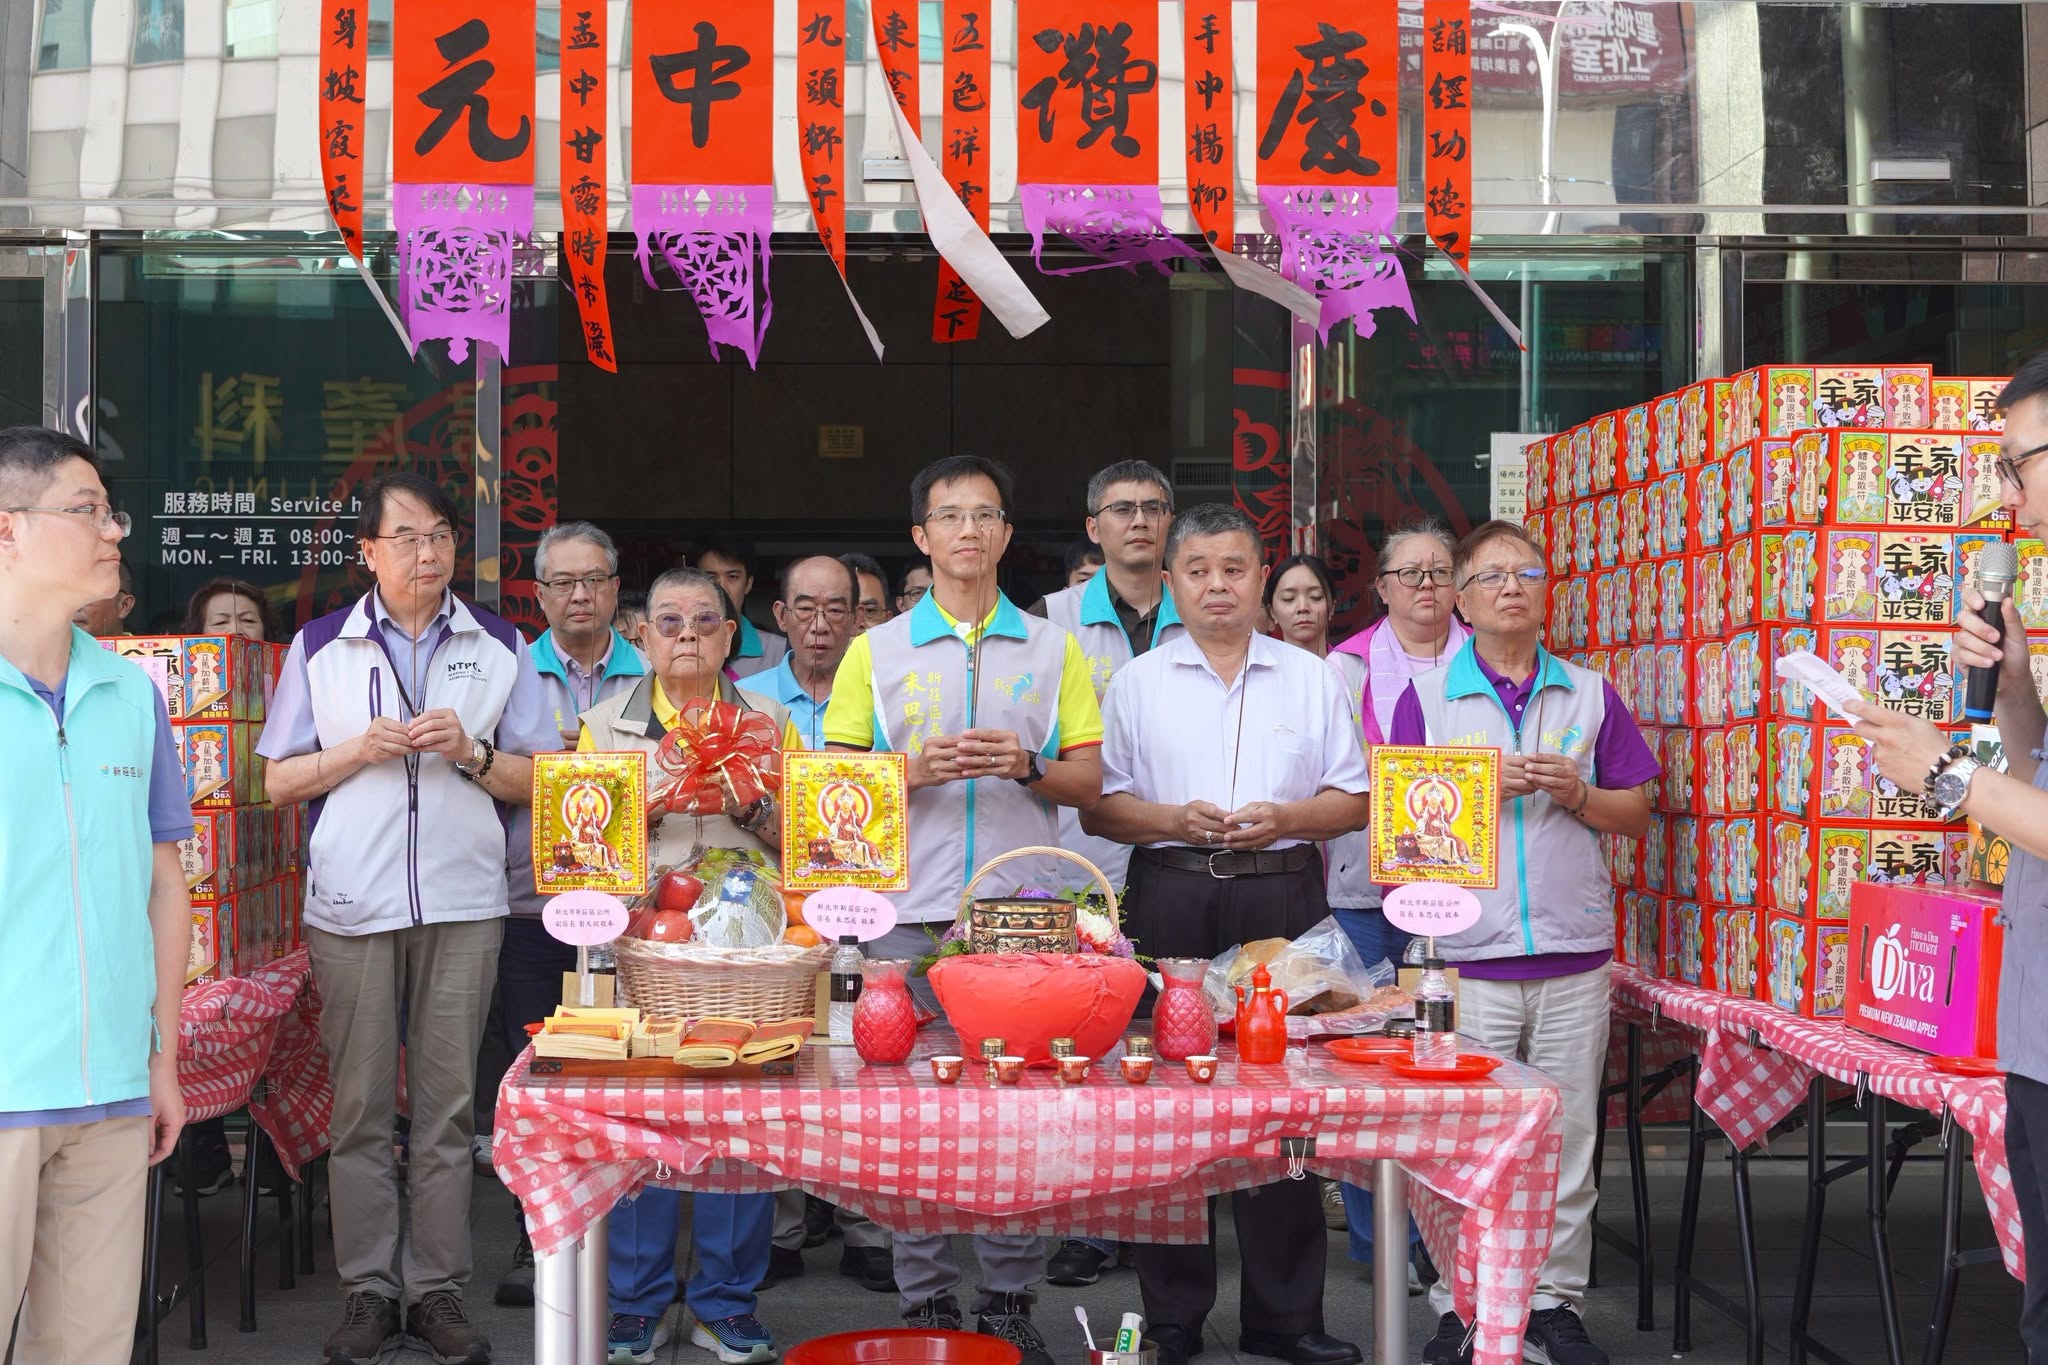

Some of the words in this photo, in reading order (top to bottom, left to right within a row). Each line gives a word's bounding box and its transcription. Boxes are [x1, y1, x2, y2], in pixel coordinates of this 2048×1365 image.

[415, 19, 531, 162] 元
[649, 21, 751, 148] 中
[1258, 22, 1387, 176] 慶
[1894, 445, 1957, 476] 全家
[164, 492, 256, 514] 服務時間
[270, 496, 343, 513] Service
[351, 494, 363, 513] h
[1893, 502, 1953, 523] 平安福
[161, 549, 213, 565] MON.
[241, 549, 278, 565] FRI.
[290, 549, 366, 566] 13:00~1
[1846, 550, 1857, 599] 小人退散符
[1884, 543, 1948, 575] 全家
[1883, 600, 1943, 621] 平安福
[1884, 642, 1948, 674] 全家
[927, 671, 944, 737] 新莊區長
[1842, 747, 1852, 796] 小人退散符
[184, 838, 194, 874] 績不敗符
[1837, 848, 1848, 897] 體脂退散符
[1876, 841, 1941, 873] 全家
[1910, 939, 1938, 956] moment
[1876, 942, 1935, 1003] Diva
[1859, 1003, 1881, 1021] PREMIUM
[1881, 1010, 1893, 1025] NEW
[1893, 1013, 1917, 1032] ZEALAND
[1917, 1021, 1939, 1039] APPLES
